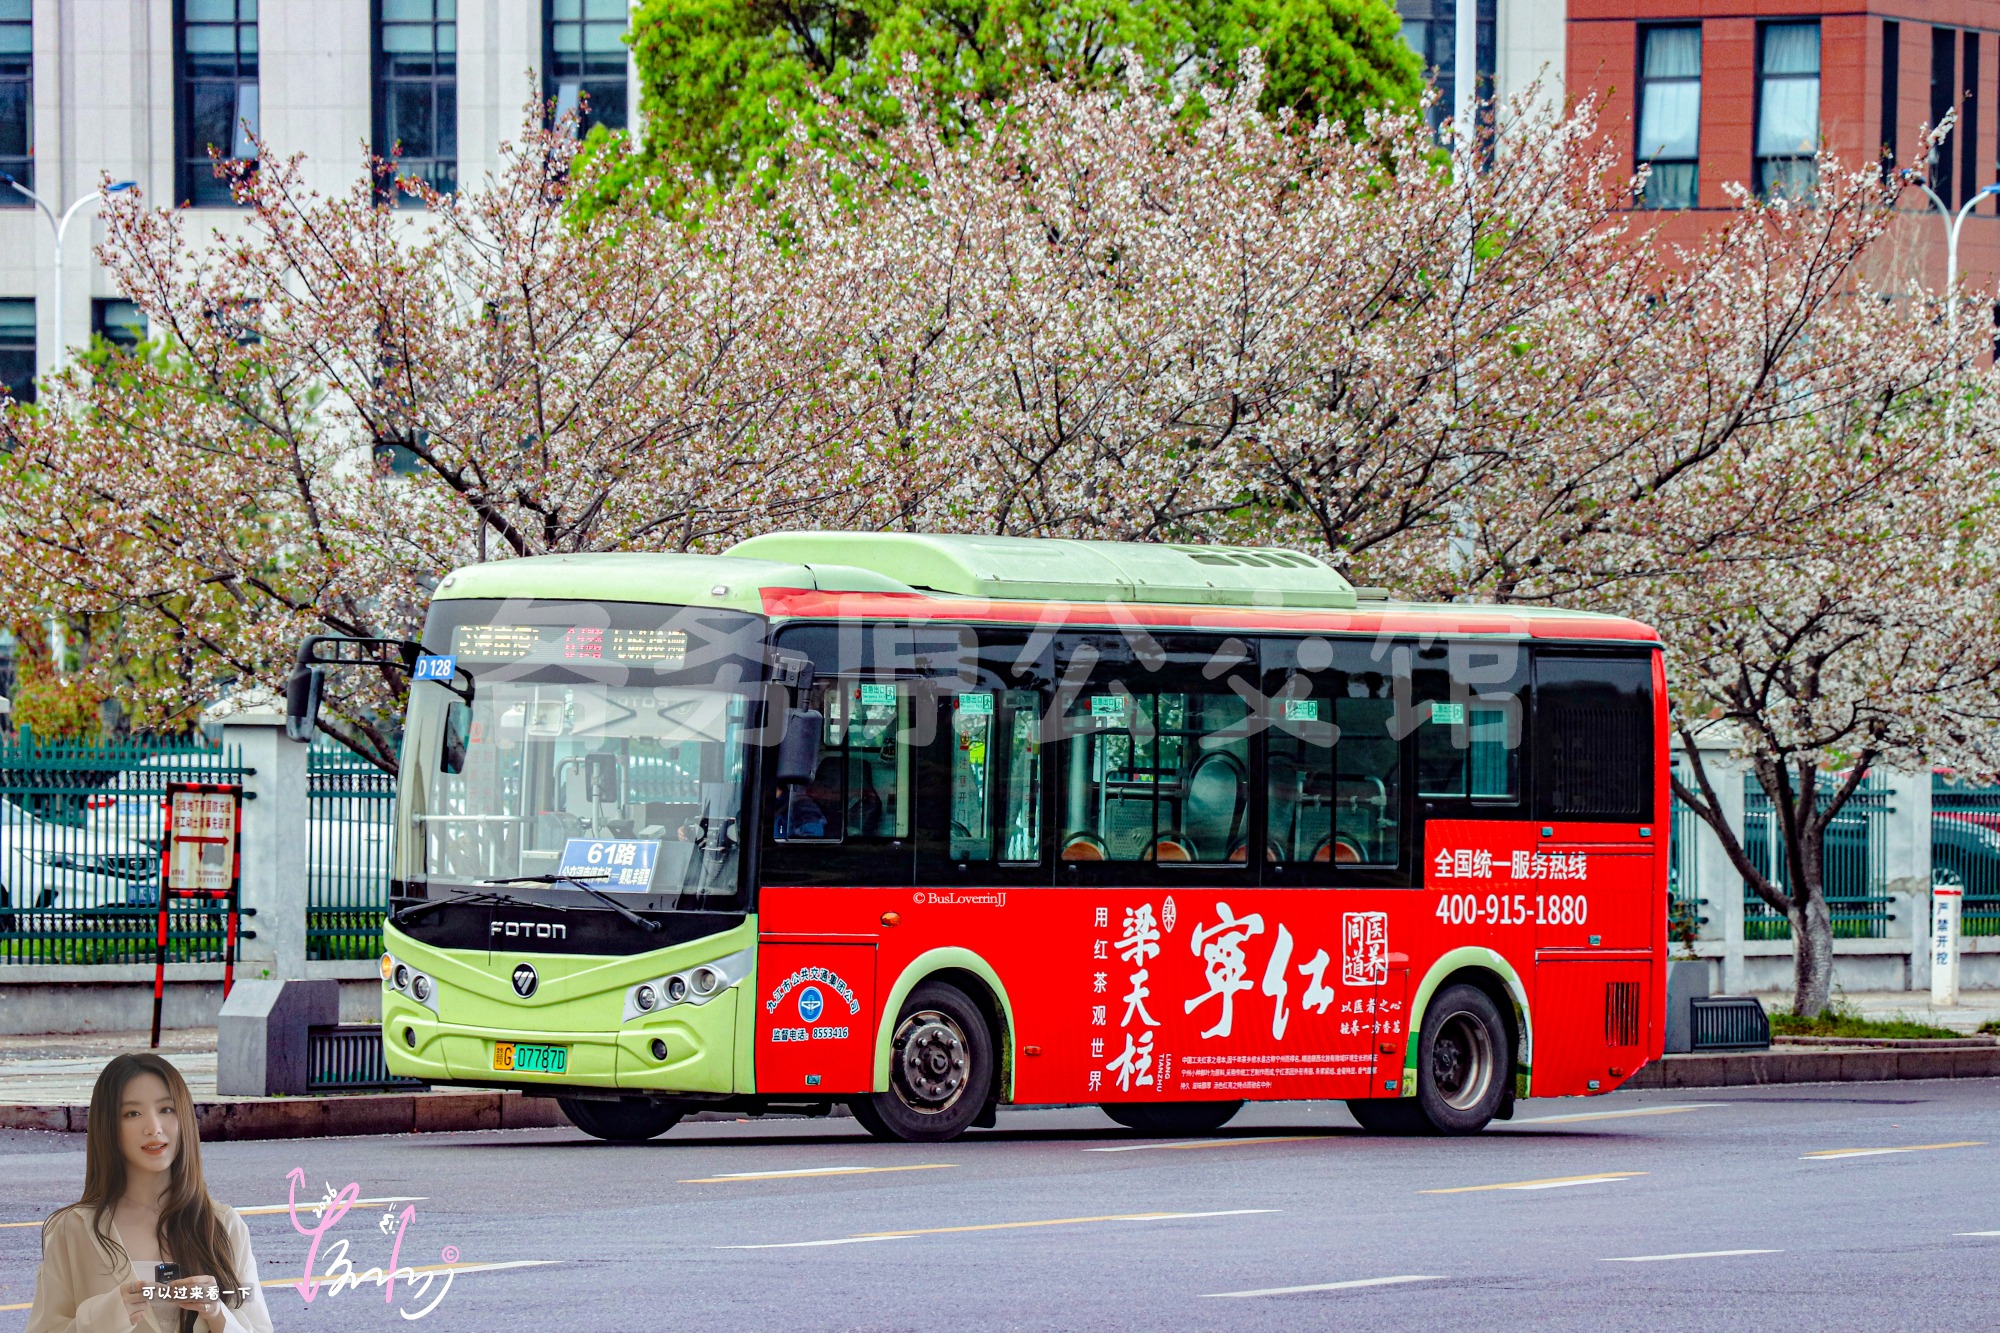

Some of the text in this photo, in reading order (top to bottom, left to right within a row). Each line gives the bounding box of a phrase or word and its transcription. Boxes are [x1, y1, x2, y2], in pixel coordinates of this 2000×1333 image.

[418, 659, 452, 677] D 128
[587, 843, 637, 866] 61路
[1434, 848, 1587, 880] 全国统一服务热线
[1435, 894, 1588, 925] 400-915-1880
[490, 921, 566, 939] FOTON
[767, 966, 860, 1015] 九江市公共交通集团公司
[1088, 907, 1108, 1092] 用红茶观世界
[1105, 903, 1161, 1092] 梁天柱
[1341, 998, 1402, 1014] 以医者之心
[813, 1027, 849, 1039] 8553416
[1156, 1053, 1164, 1092] TIANZHU
